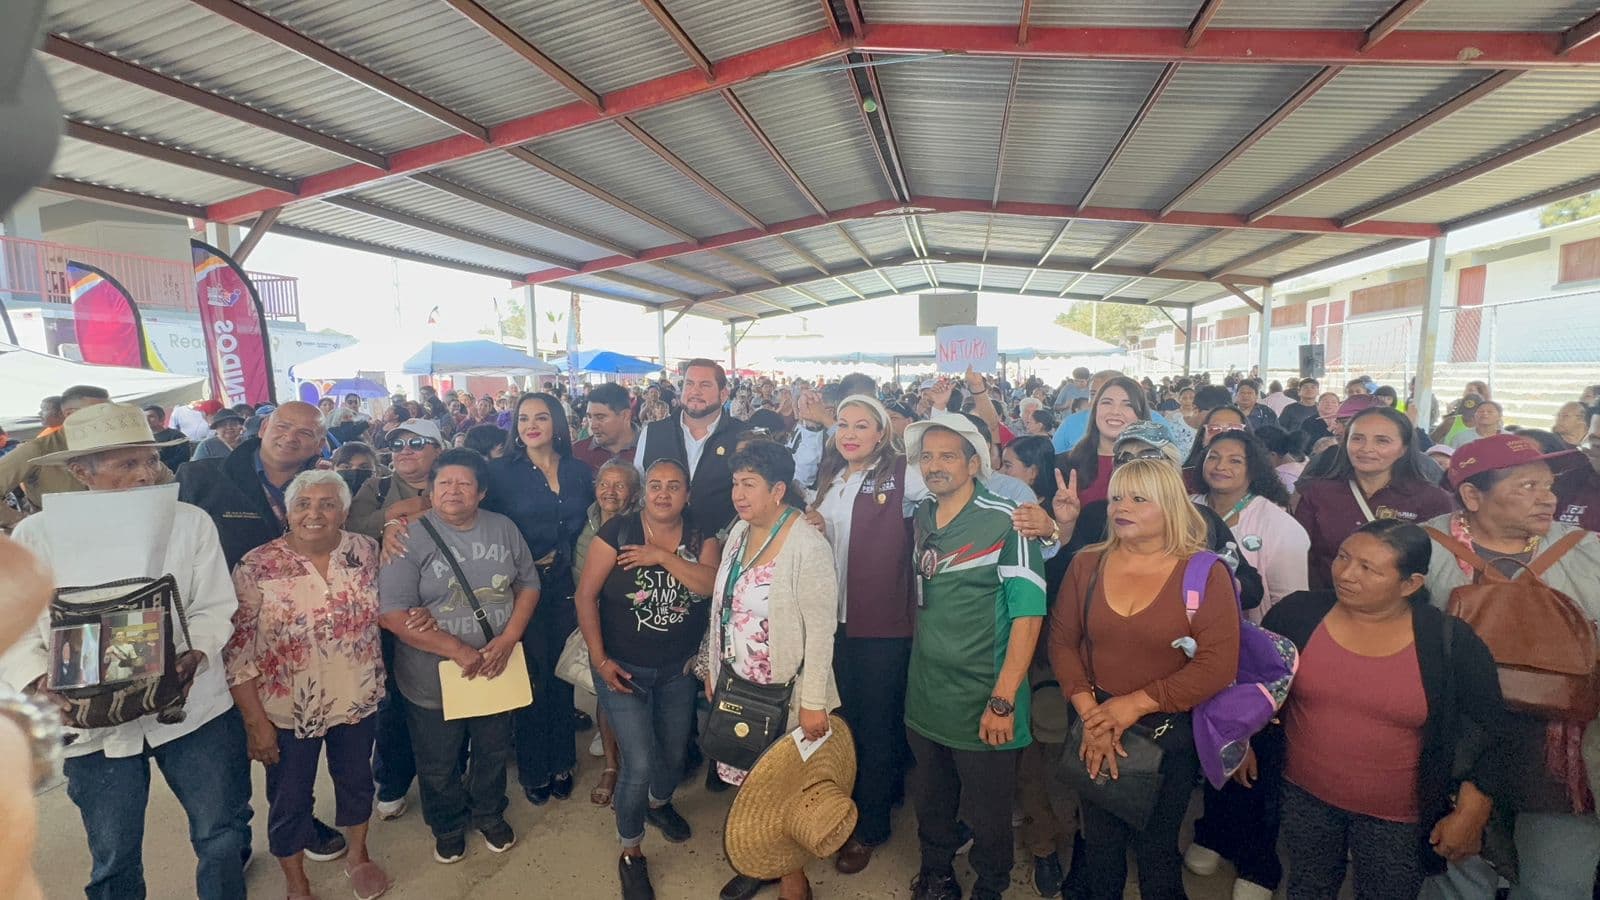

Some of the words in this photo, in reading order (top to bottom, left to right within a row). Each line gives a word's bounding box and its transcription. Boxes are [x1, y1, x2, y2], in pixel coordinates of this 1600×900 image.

[431, 545, 466, 579] AL
[471, 542, 512, 563] DAY
[651, 588, 677, 604] AND
